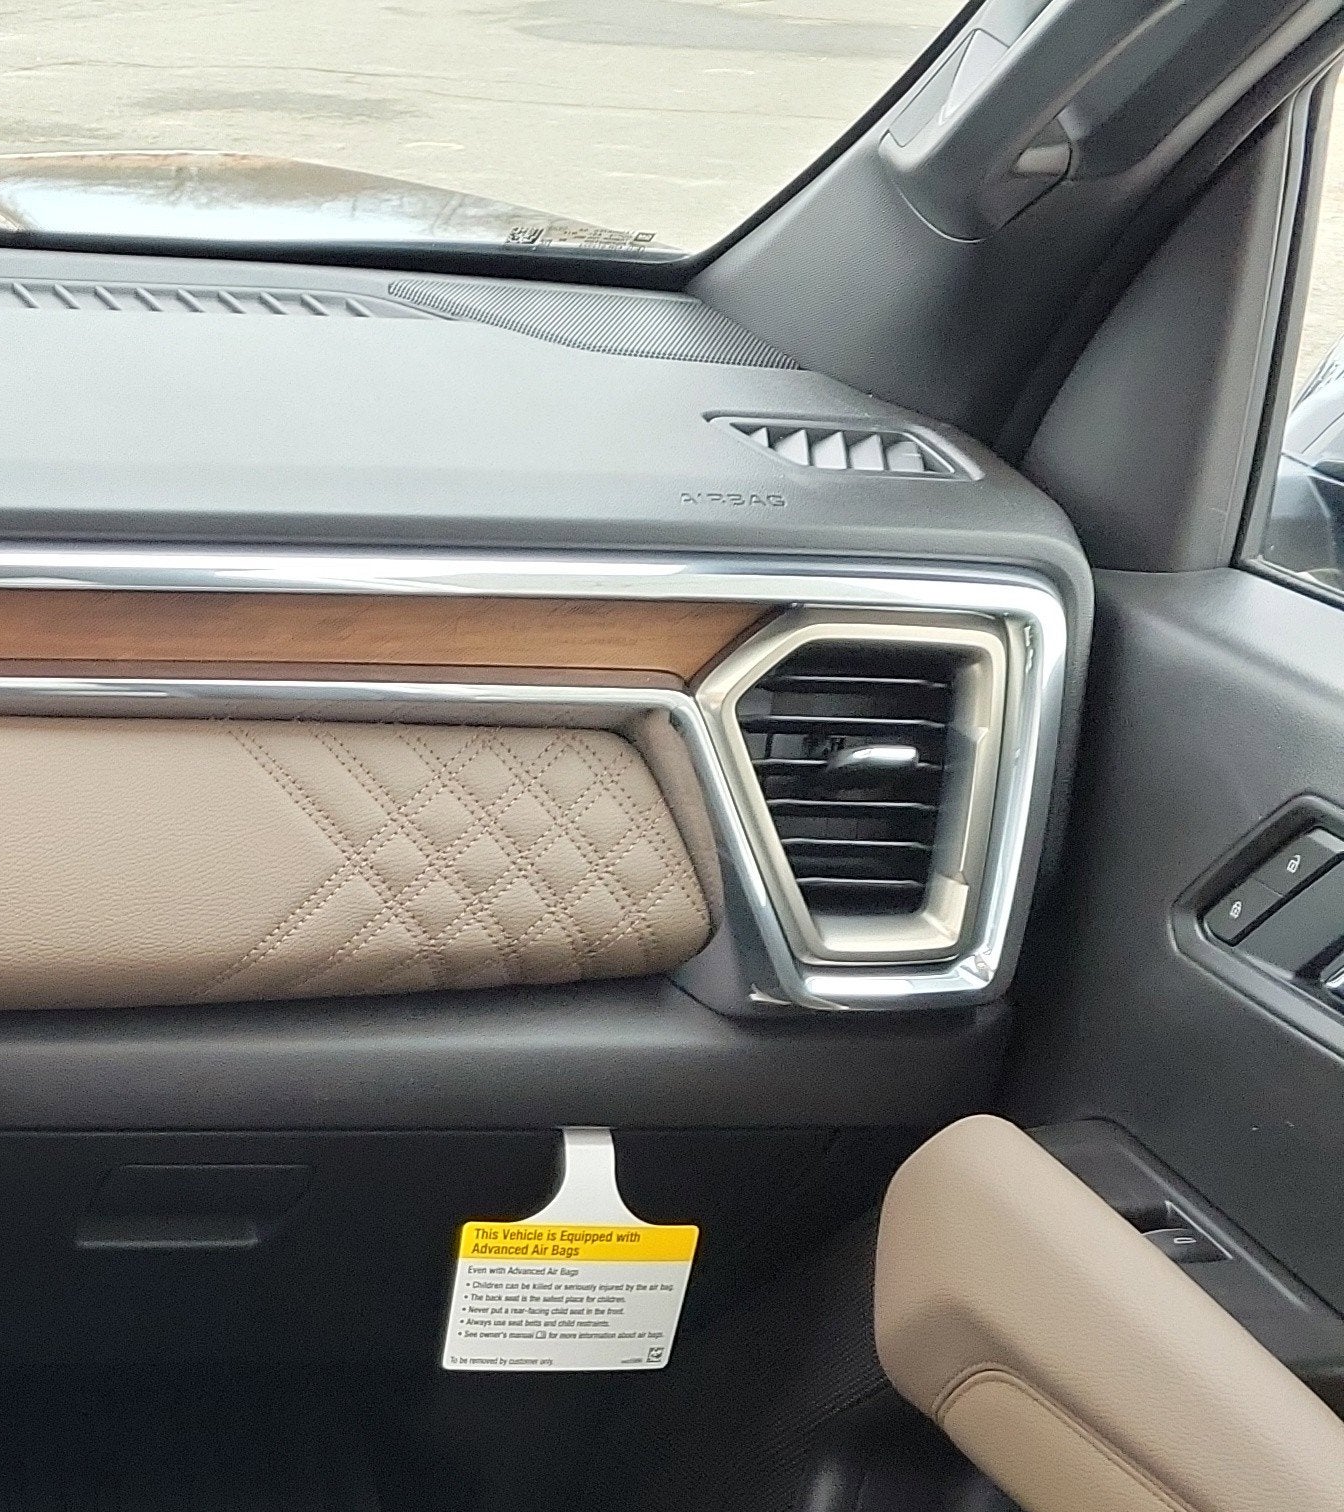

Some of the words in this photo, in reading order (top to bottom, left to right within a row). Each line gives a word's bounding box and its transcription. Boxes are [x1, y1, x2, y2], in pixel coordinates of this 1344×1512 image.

[475, 1228, 498, 1240] This
[502, 1229, 543, 1241] Vehicle
[546, 1230, 557, 1241] is
[560, 1230, 613, 1244] Equipped
[616, 1231, 641, 1242] with
[471, 1243, 529, 1255] Advanced
[531, 1244, 549, 1256] Air
[551, 1245, 580, 1258] Bags
[468, 1265, 487, 1274] Even
[489, 1266, 506, 1274] with
[507, 1267, 546, 1275] Advanced
[547, 1267, 558, 1275] Air
[560, 1268, 579, 1277] Bags
[472, 1281, 503, 1289] Children
[471, 1293, 483, 1301] The
[466, 1319, 492, 1327] Always
